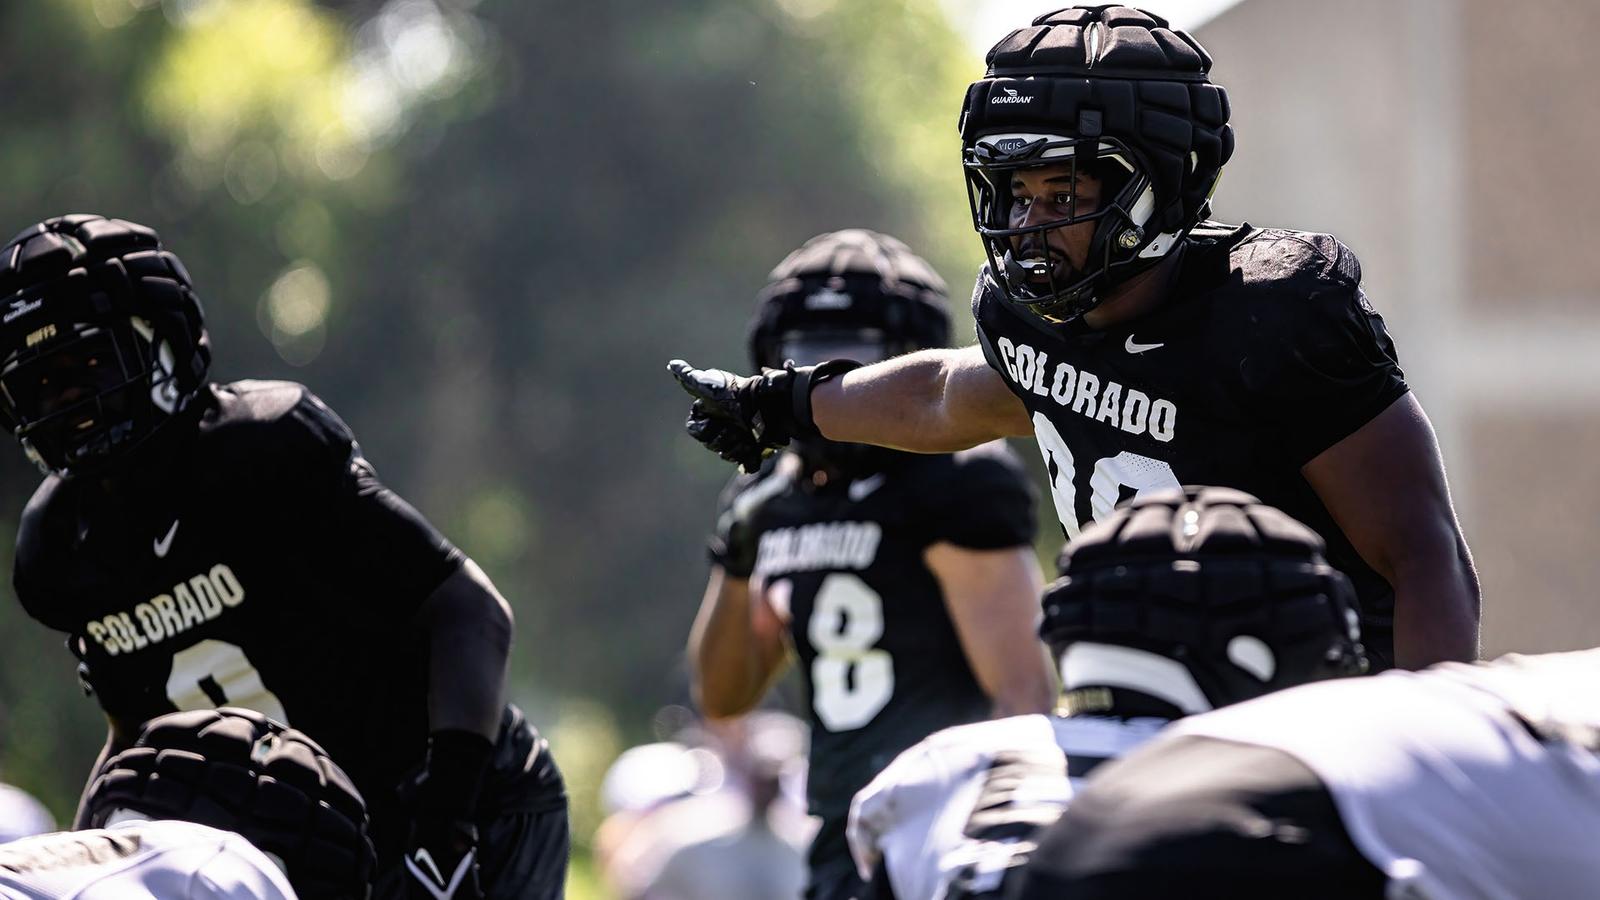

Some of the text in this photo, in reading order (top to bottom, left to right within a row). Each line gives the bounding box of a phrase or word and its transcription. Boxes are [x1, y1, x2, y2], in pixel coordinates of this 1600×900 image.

[991, 96, 1031, 104] GUARDIAN
[999, 142, 1021, 150] VICIS
[998, 336, 1177, 443] COLORADO
[87, 563, 245, 656] COLORADO
[768, 571, 895, 733] 8
